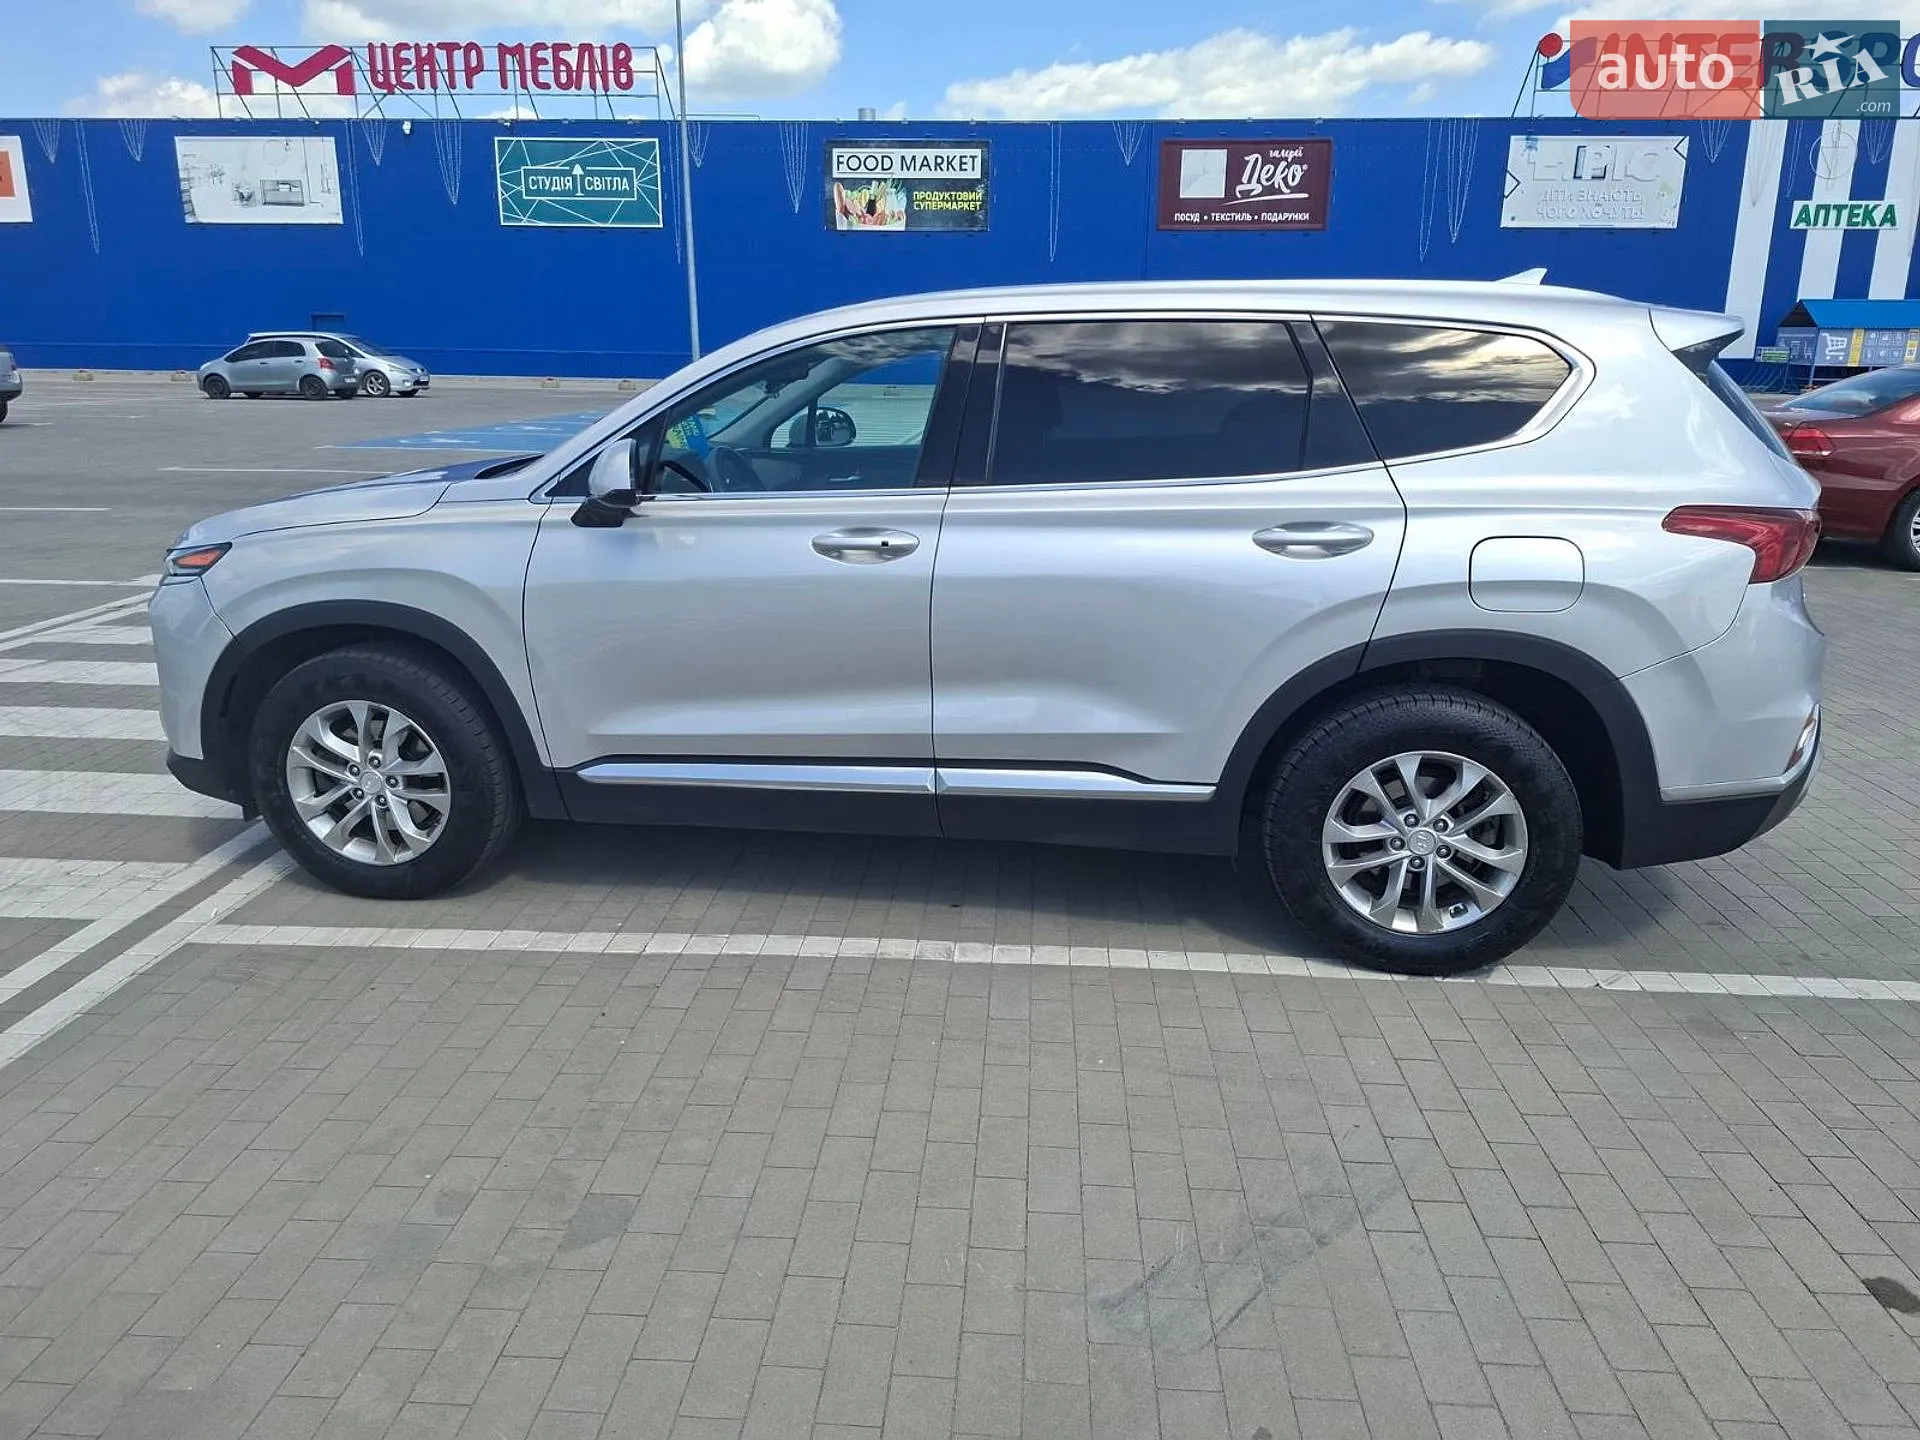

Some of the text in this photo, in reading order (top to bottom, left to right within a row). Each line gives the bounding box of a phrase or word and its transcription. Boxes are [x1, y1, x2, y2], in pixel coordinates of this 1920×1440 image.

[368, 42, 633, 94] ЦЕНТР МЕБЛІВ
[836, 154, 978, 172] FOOD MARKET
[528, 176, 630, 191] СТУДІЯ СВІТЛА
[1235, 153, 1304, 198] Деко
[913, 201, 982, 211] СУПЕРМАРКЕТ
[1793, 203, 1897, 227] АПТЕКА
[1174, 212, 1310, 222] ПОСУД ТЕКСТИЛЬ ПОДАРУНКИ
